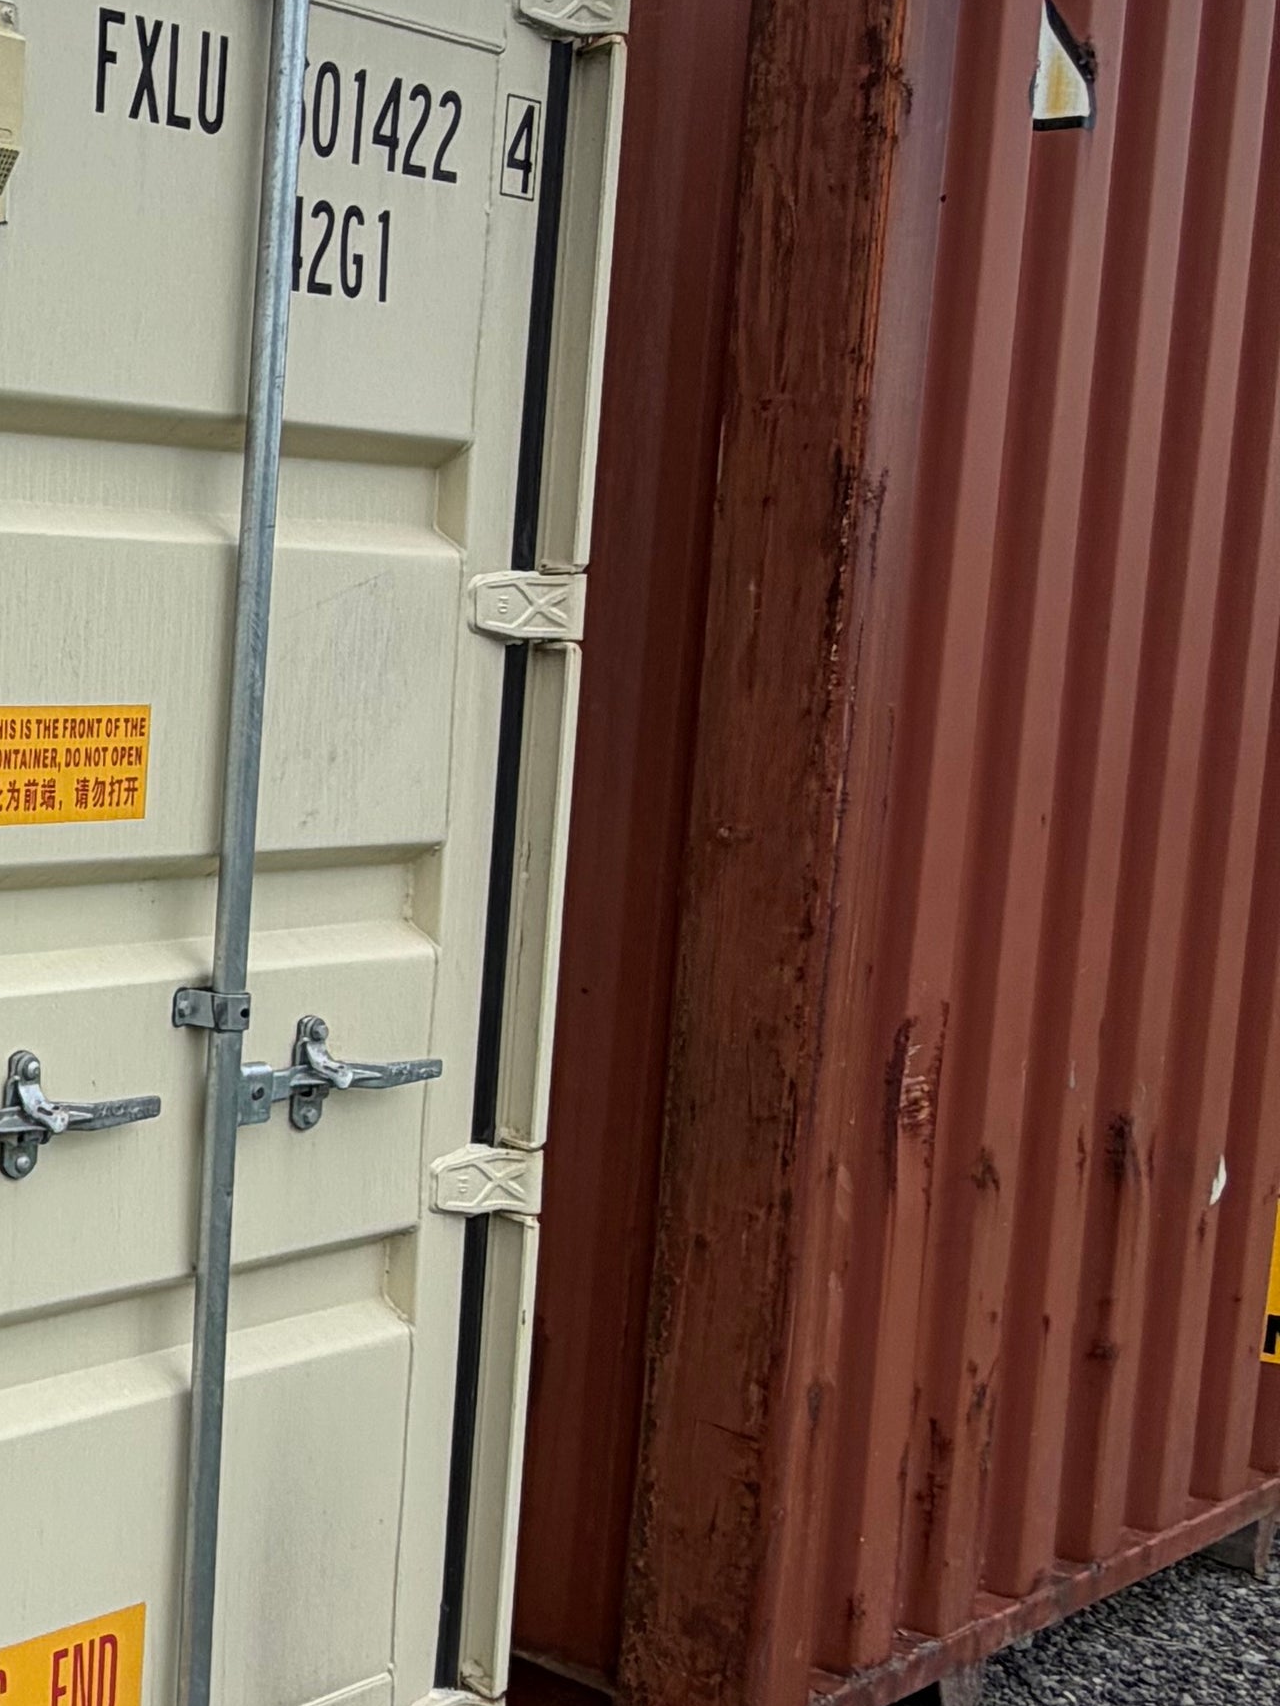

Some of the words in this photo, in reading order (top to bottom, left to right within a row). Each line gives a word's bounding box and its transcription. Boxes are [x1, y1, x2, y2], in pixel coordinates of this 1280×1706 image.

[95, 7, 228, 135] FXLU
[299, 56, 462, 183] 01422
[507, 105, 535, 193] 4
[19, 719, 32, 739] IS
[35, 718, 59, 739] THE
[62, 718, 102, 739] FRONT
[105, 717, 120, 738] OF
[123, 717, 146, 738] THE
[64, 747, 81, 767] DO
[83, 746, 109, 767] NOT
[111, 746, 142, 766] OPEN
